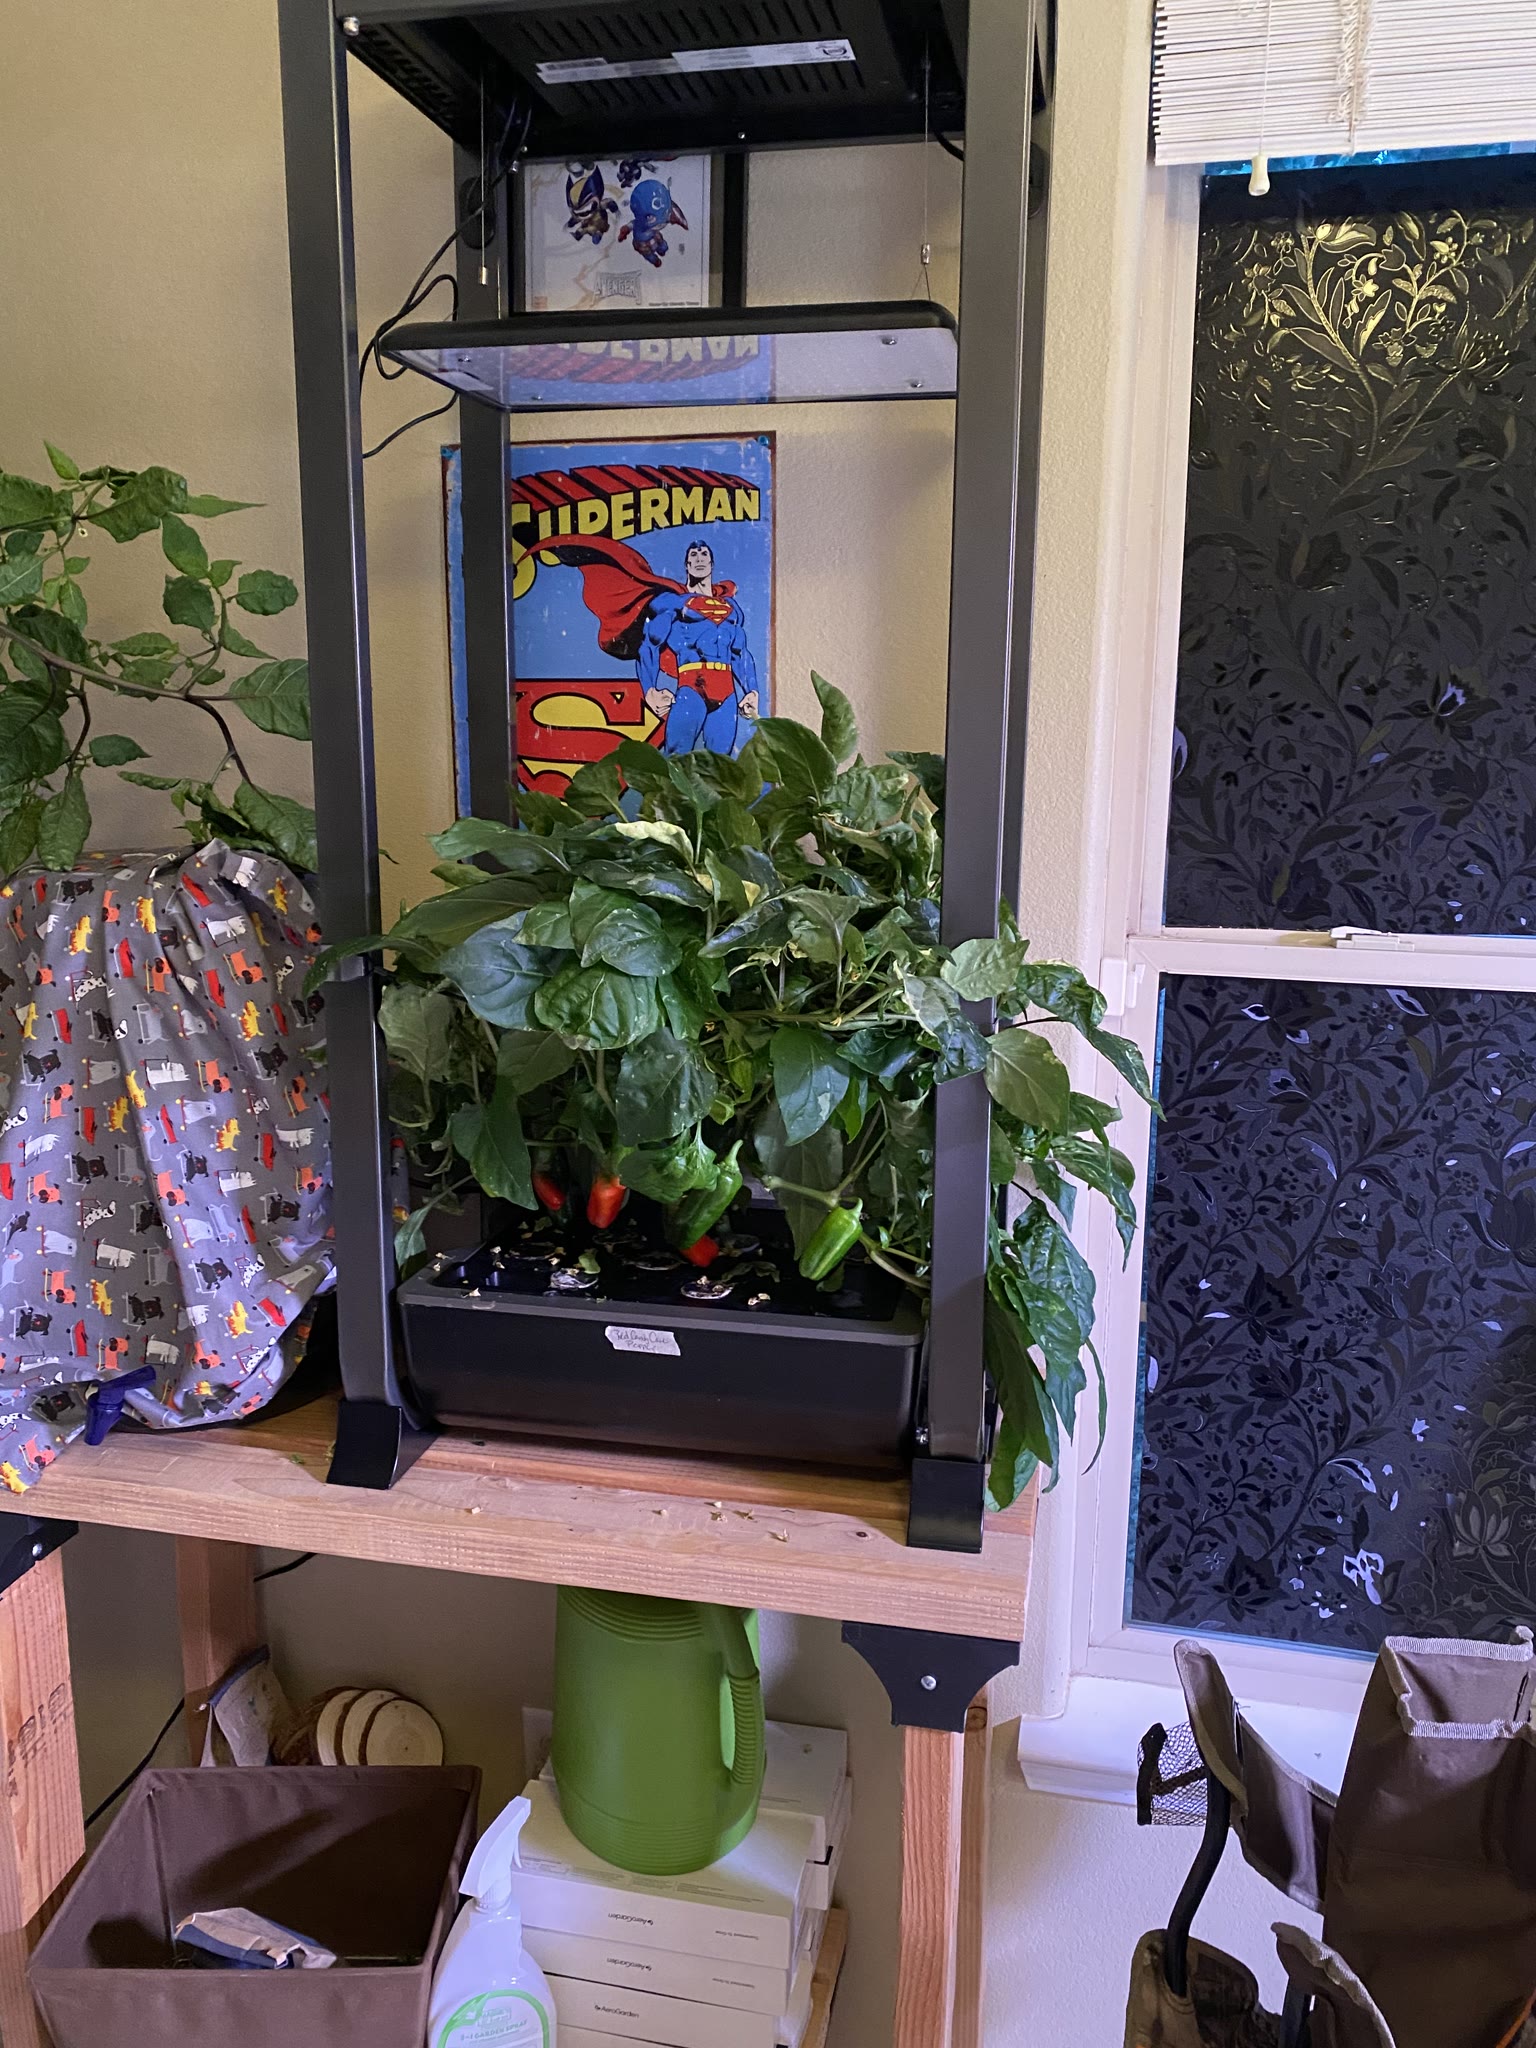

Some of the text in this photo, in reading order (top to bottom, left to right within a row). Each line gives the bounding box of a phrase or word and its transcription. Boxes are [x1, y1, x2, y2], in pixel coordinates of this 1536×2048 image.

[608, 1912, 647, 1925] AeroGarden
[607, 1958, 645, 1970] AeroGarden
[601, 2005, 640, 2018] AeroGarden
